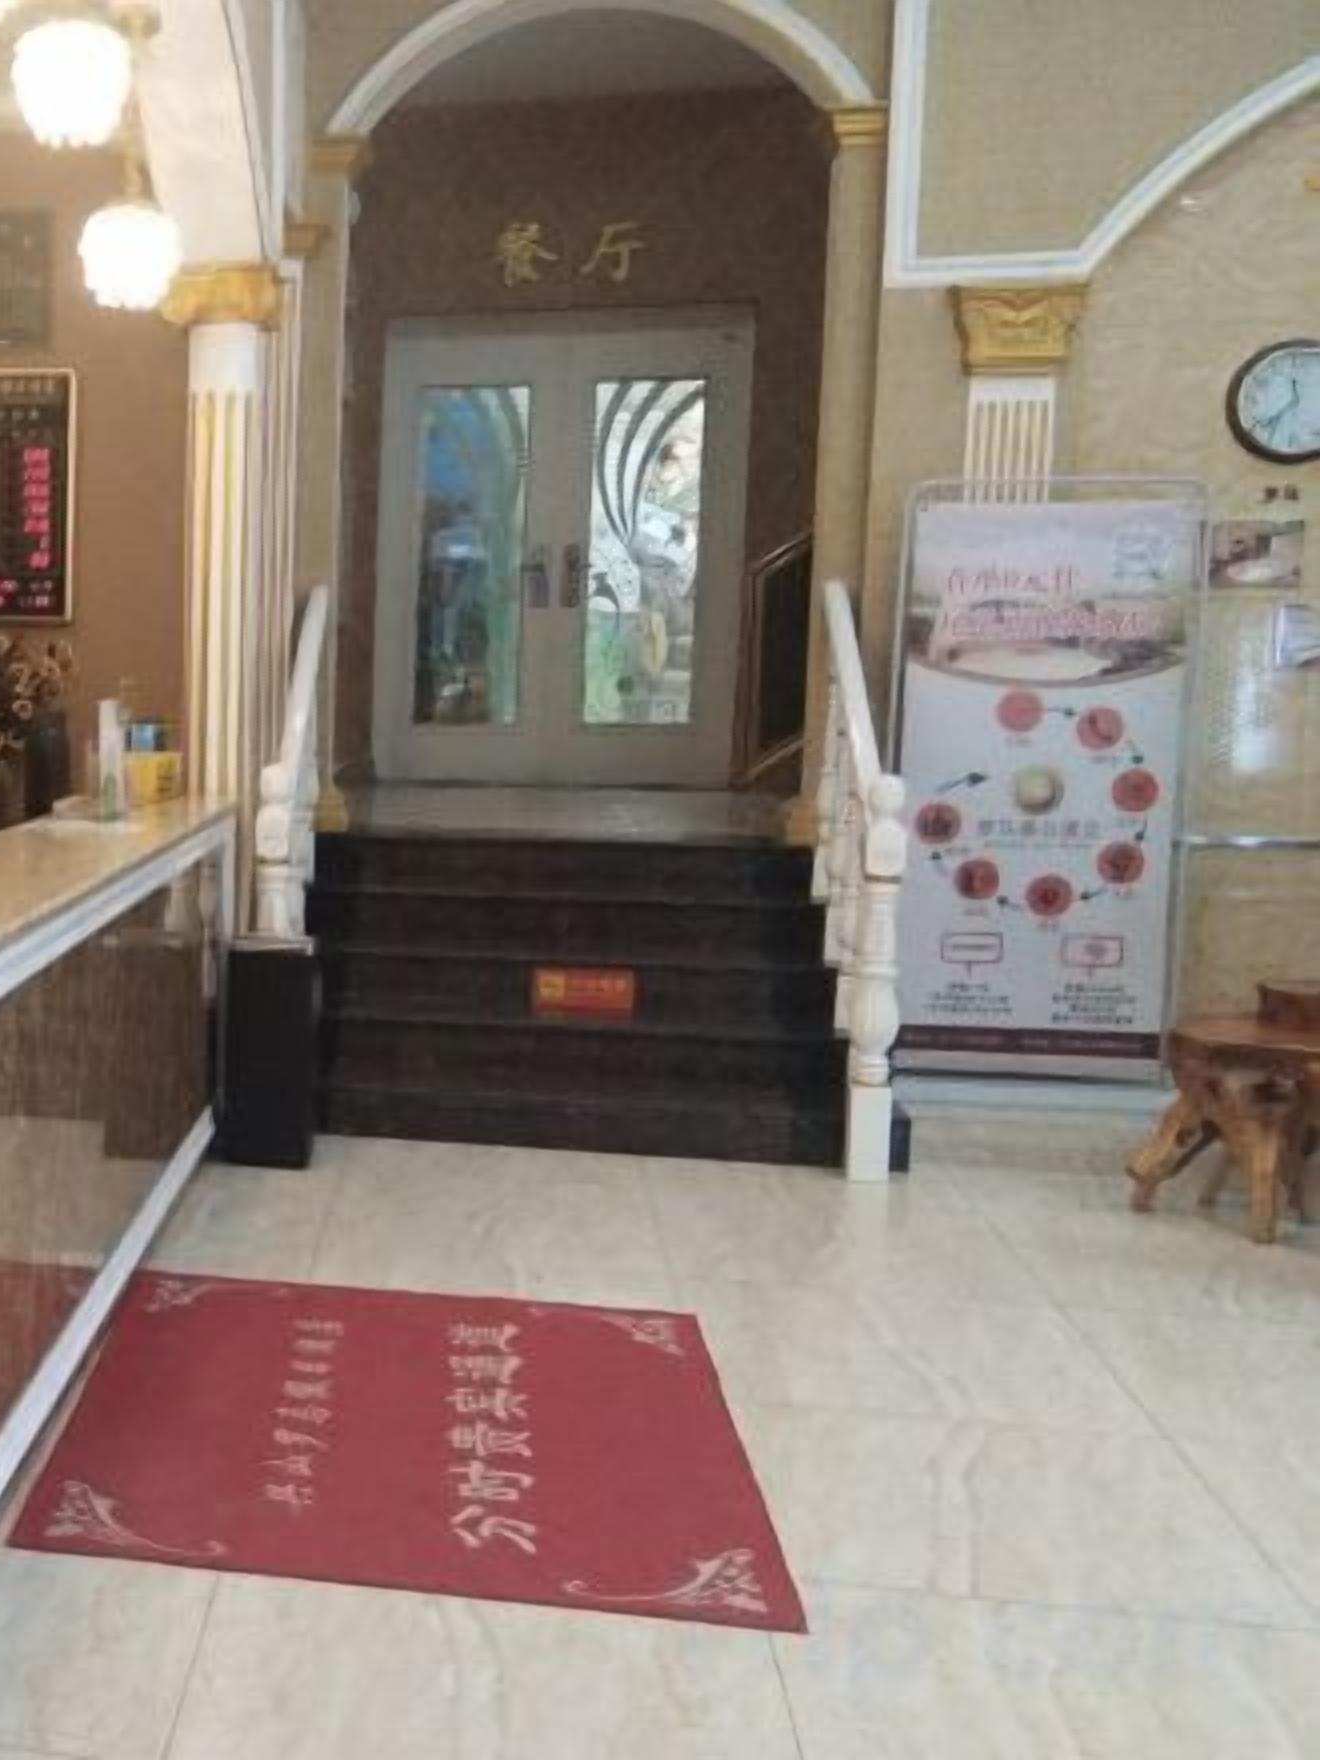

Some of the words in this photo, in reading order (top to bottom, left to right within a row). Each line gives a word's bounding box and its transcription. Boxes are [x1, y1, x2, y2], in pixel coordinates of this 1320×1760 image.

[494, 223, 645, 286] 餐厅
[445, 1323, 536, 1554] 分时贵宾通道
